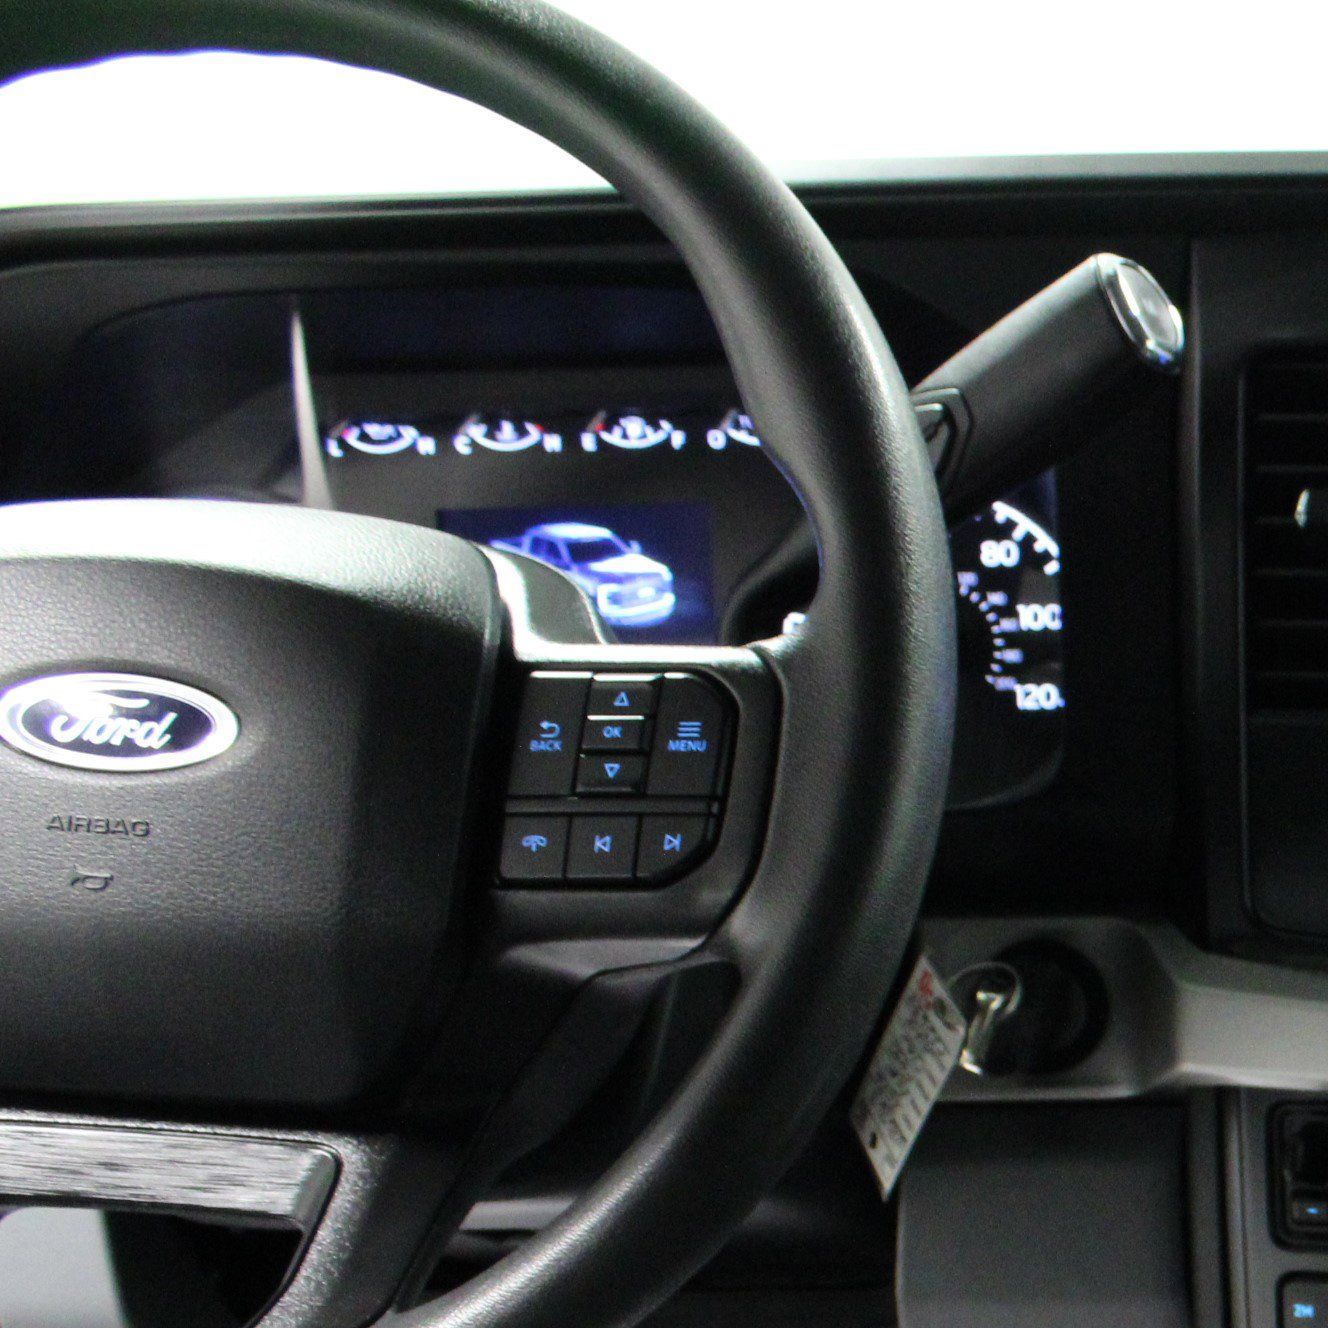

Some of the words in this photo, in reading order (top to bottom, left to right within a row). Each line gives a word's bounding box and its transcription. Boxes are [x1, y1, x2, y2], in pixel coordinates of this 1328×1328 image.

[980, 540, 1020, 568] 80
[1015, 603, 1062, 631] 100
[1014, 683, 1060, 710] 120
[50, 690, 177, 749] Ford
[603, 726, 623, 738] OK
[530, 740, 562, 752] BACK
[668, 740, 708, 752] MENU
[47, 815, 150, 837] AIRBAG
